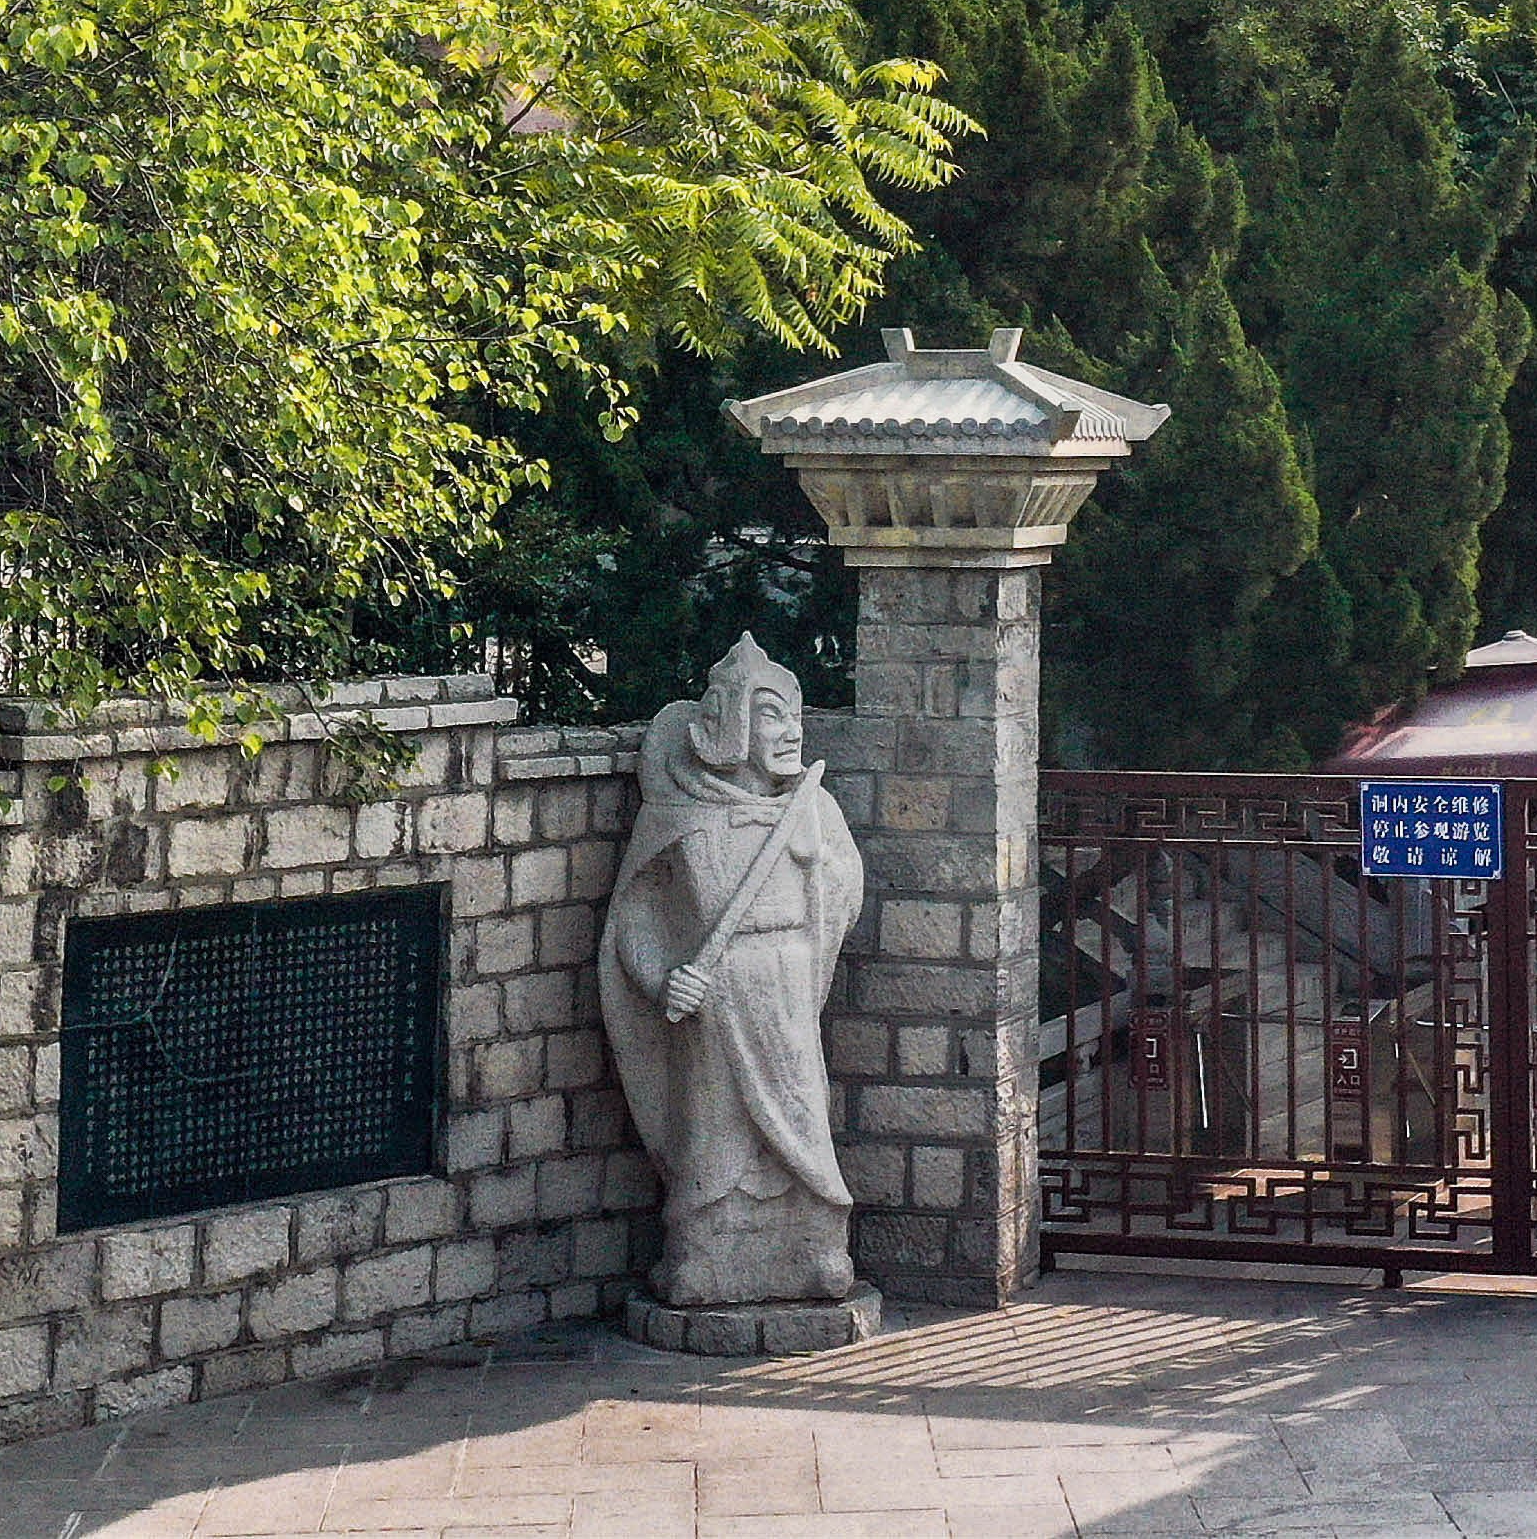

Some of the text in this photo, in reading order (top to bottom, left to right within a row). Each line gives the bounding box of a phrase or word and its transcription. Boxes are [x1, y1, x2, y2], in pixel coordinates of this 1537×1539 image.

[1371, 795, 1489, 815] 洞内安全维修
[1373, 820, 1490, 841] 停止参观游览
[1372, 845, 1492, 867] 敬请谅解
